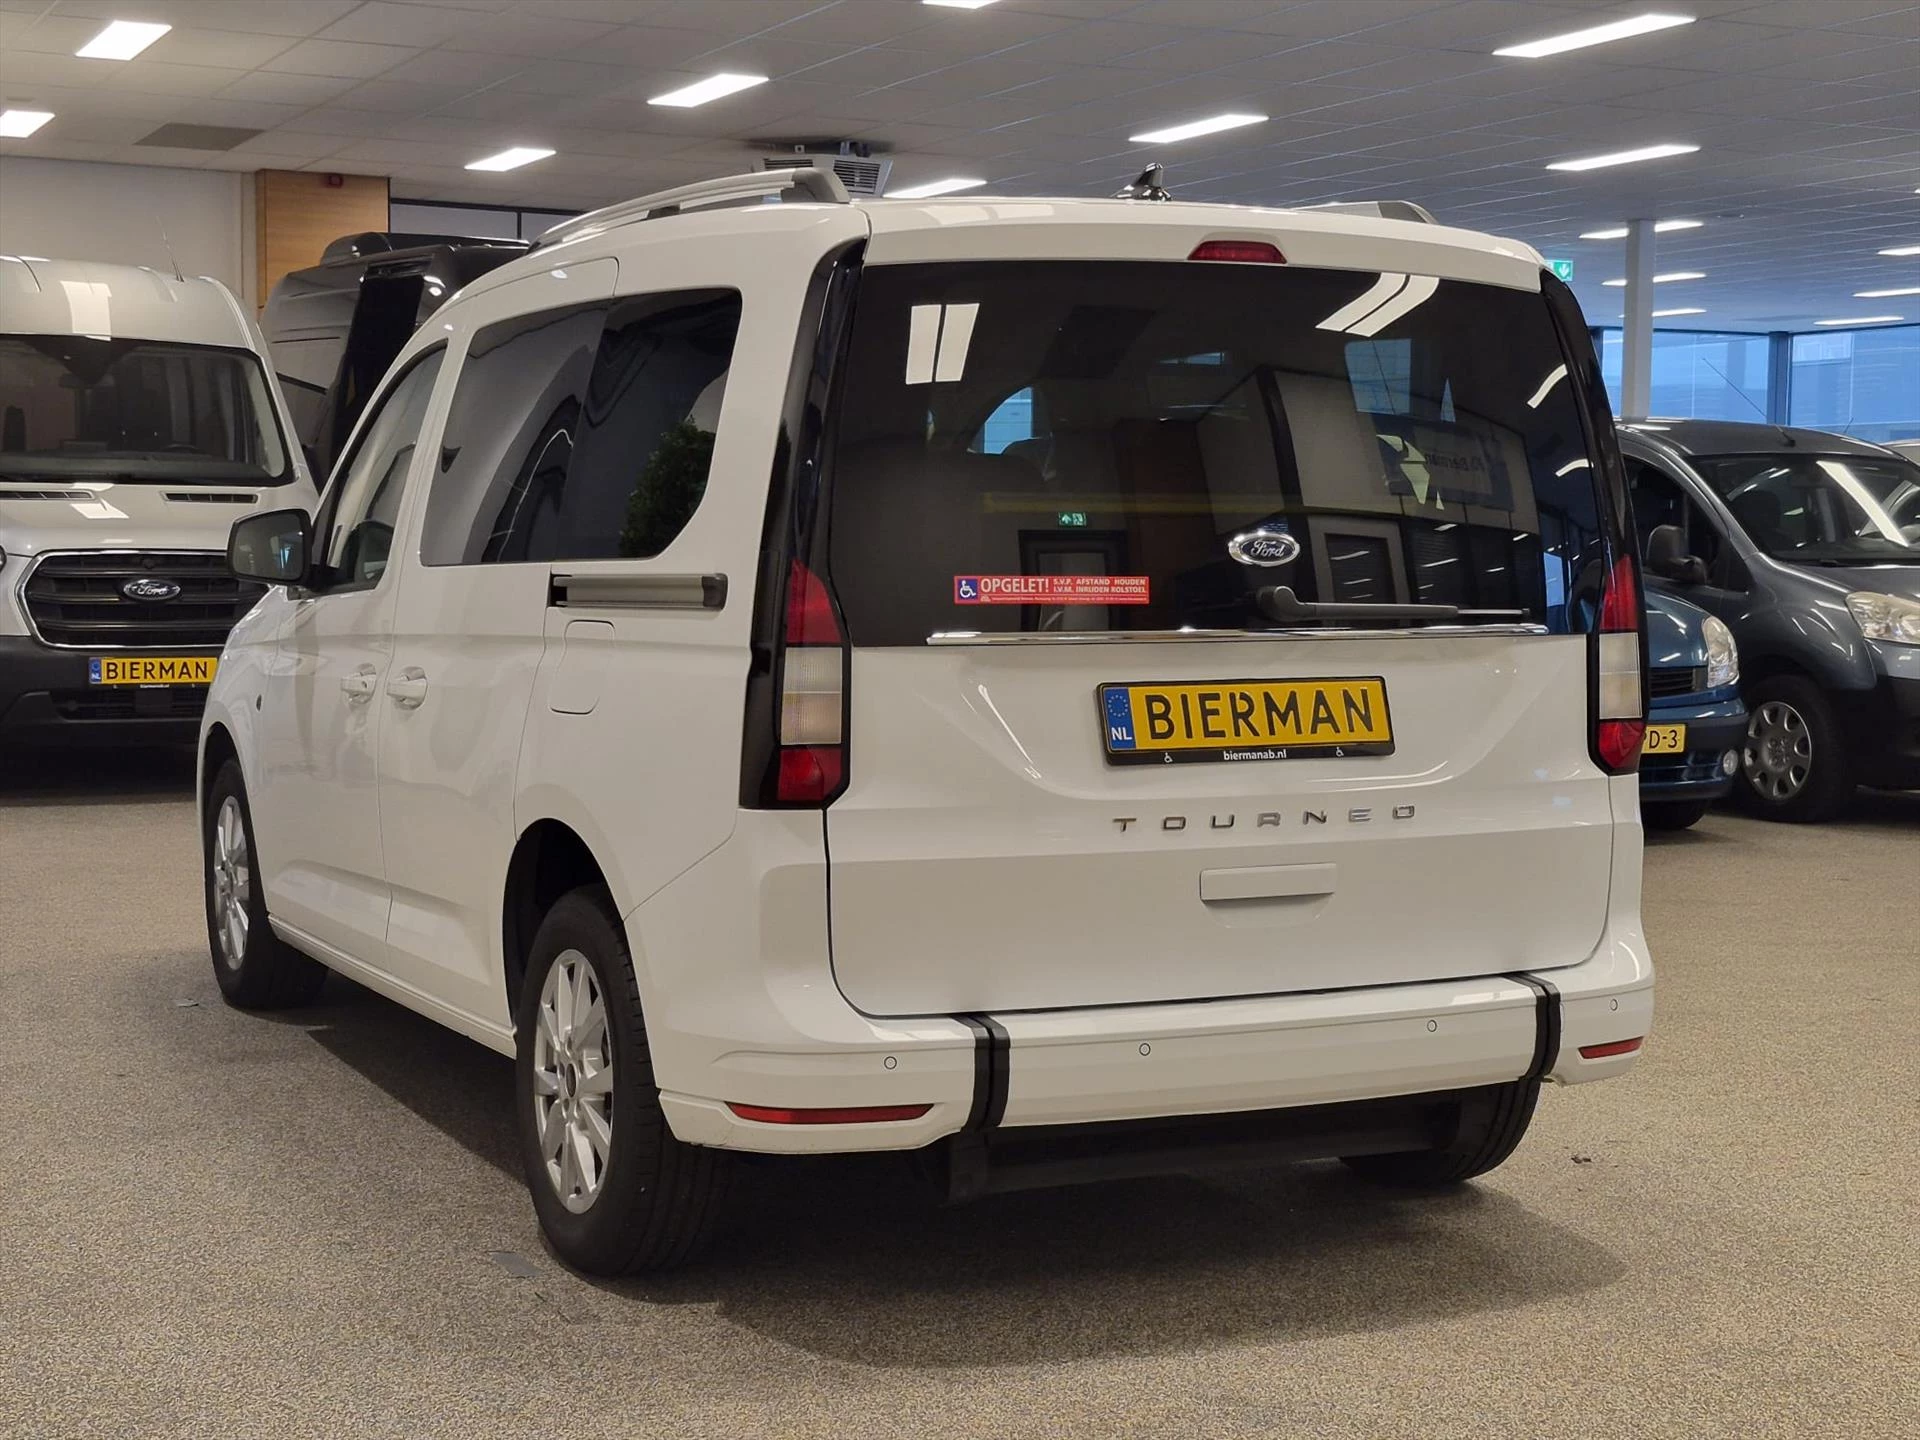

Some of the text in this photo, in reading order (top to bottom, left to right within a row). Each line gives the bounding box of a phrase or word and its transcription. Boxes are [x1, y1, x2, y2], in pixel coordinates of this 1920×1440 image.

[1250, 540, 1286, 558] Ford
[136, 582, 169, 596] Ford
[980, 578, 1049, 593] OPGELET!
[106, 661, 208, 680] BIERMAN
[1144, 687, 1374, 740] BIERMAN
[1111, 726, 1133, 741] NL
[1644, 729, 1678, 749] D-3
[1223, 749, 1287, 761] biermanab.nl
[1112, 805, 1415, 832] TOURNEO
